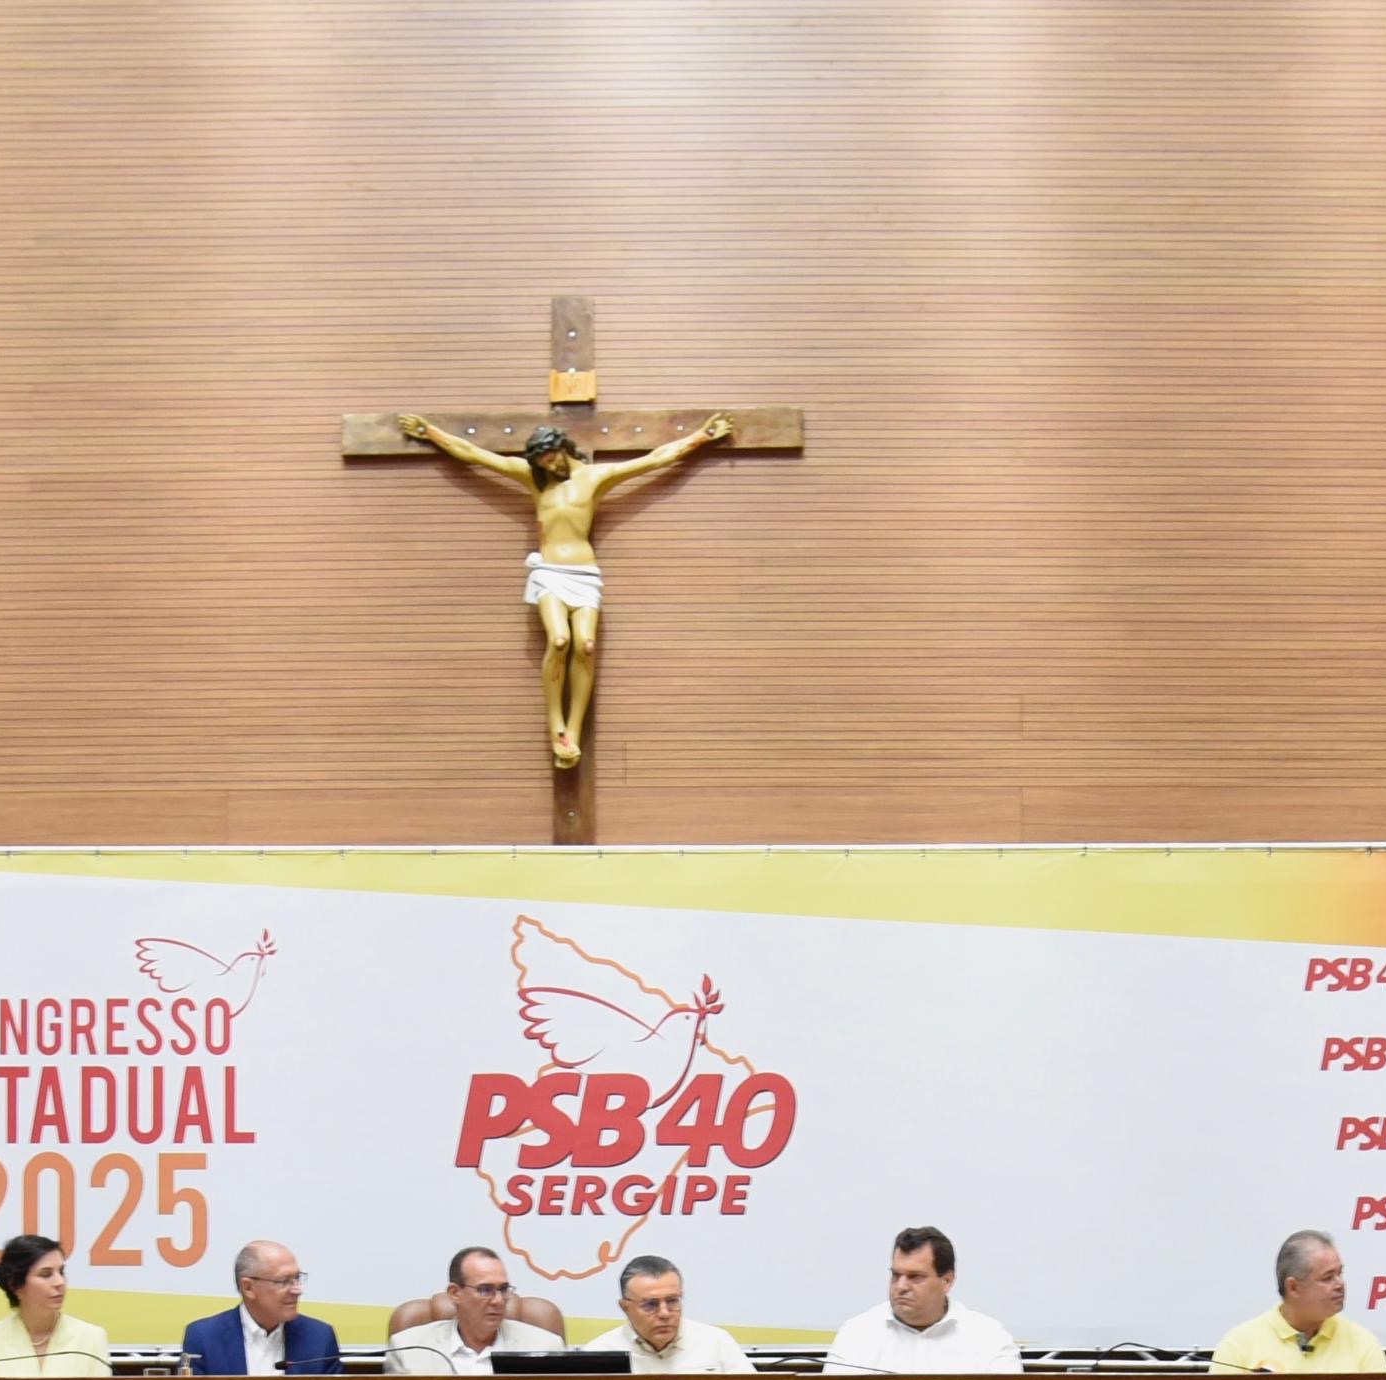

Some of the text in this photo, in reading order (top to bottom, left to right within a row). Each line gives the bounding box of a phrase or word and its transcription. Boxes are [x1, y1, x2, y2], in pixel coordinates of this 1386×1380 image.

[1304, 957, 1374, 992] PSB
[454, 1072, 796, 1169] PSB 40
[502, 1175, 751, 1216] SERGIPE
